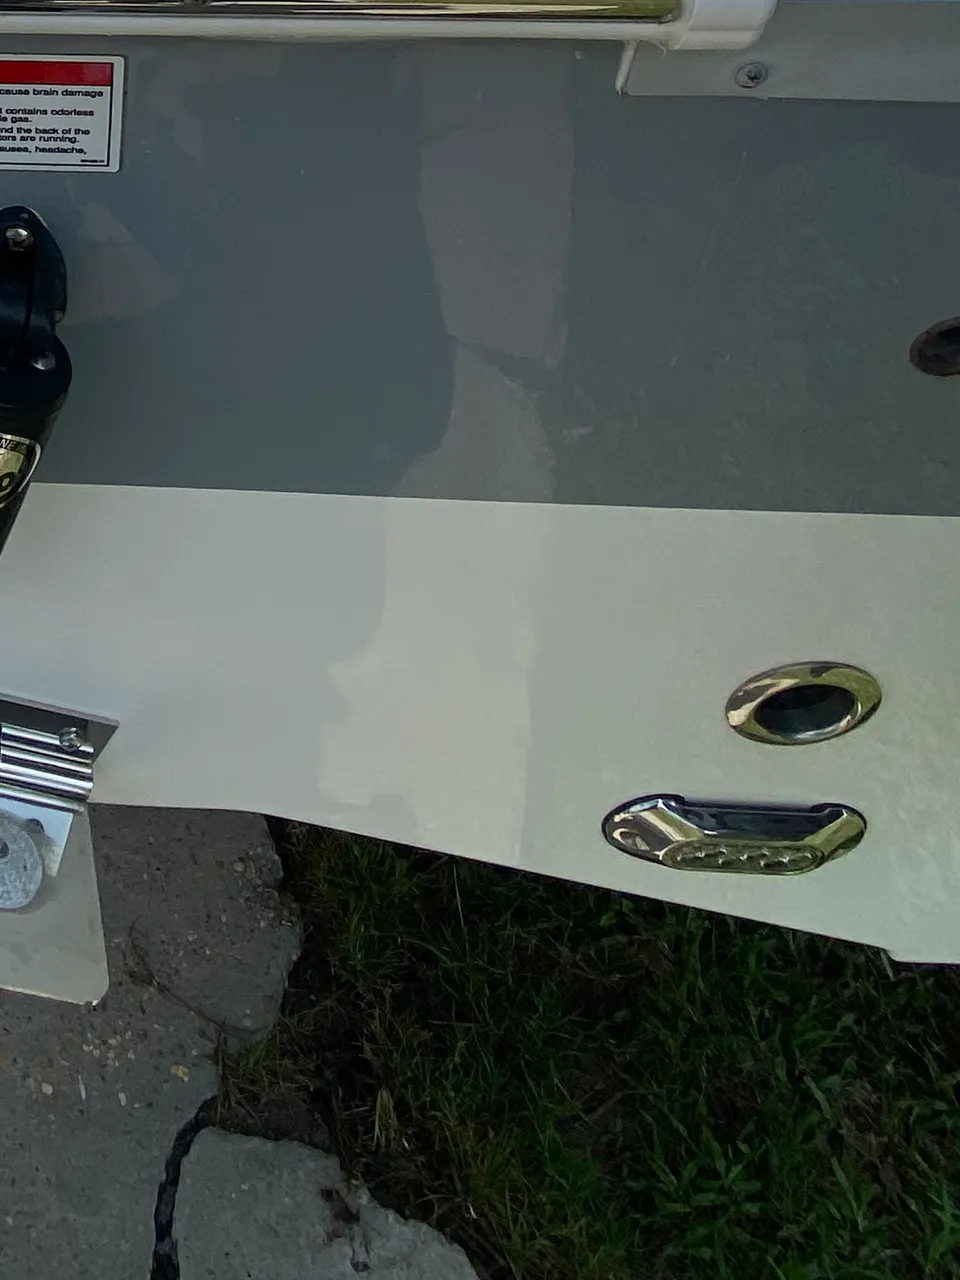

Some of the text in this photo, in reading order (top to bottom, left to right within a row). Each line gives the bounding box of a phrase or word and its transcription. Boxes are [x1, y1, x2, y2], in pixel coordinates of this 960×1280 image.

[0, 88, 30, 96] cause
[32, 88, 59, 96] brain
[61, 89, 104, 98] damage
[5, 107, 48, 115] contains
[50, 108, 95, 116] odorless
[10, 116, 32, 124] gas.
[35, 127, 59, 135] back
[61, 127, 72, 135] of
